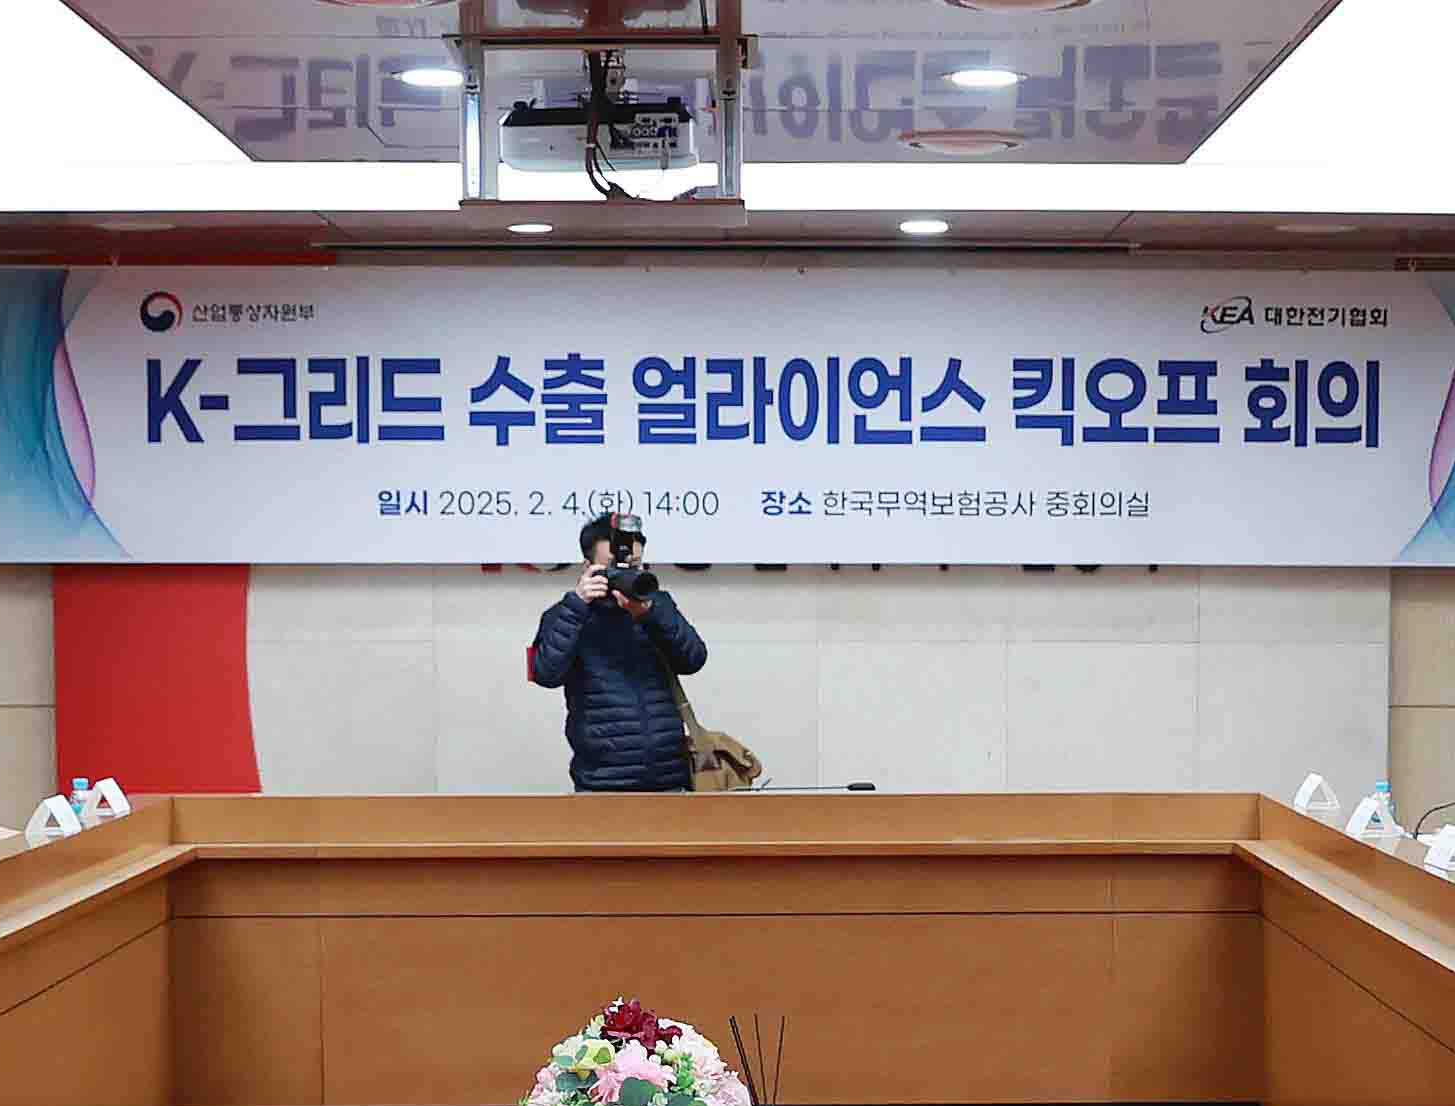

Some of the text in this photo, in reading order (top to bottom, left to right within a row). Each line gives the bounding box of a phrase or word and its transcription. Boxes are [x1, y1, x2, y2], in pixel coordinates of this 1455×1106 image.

[192, 303, 315, 322] 산업통상자원부
[1201, 302, 1389, 327] KEA 대한전기협회
[146, 354, 1380, 448] K-그리드 수출 얼라이언스 킥오프 회의
[377, 489, 428, 517] 일시
[439, 490, 518, 517] 2025.
[528, 490, 552, 516] 2.
[644, 490, 719, 516] 14:00
[761, 489, 1150, 518] 장소 한국무역보험공사 중회의실
